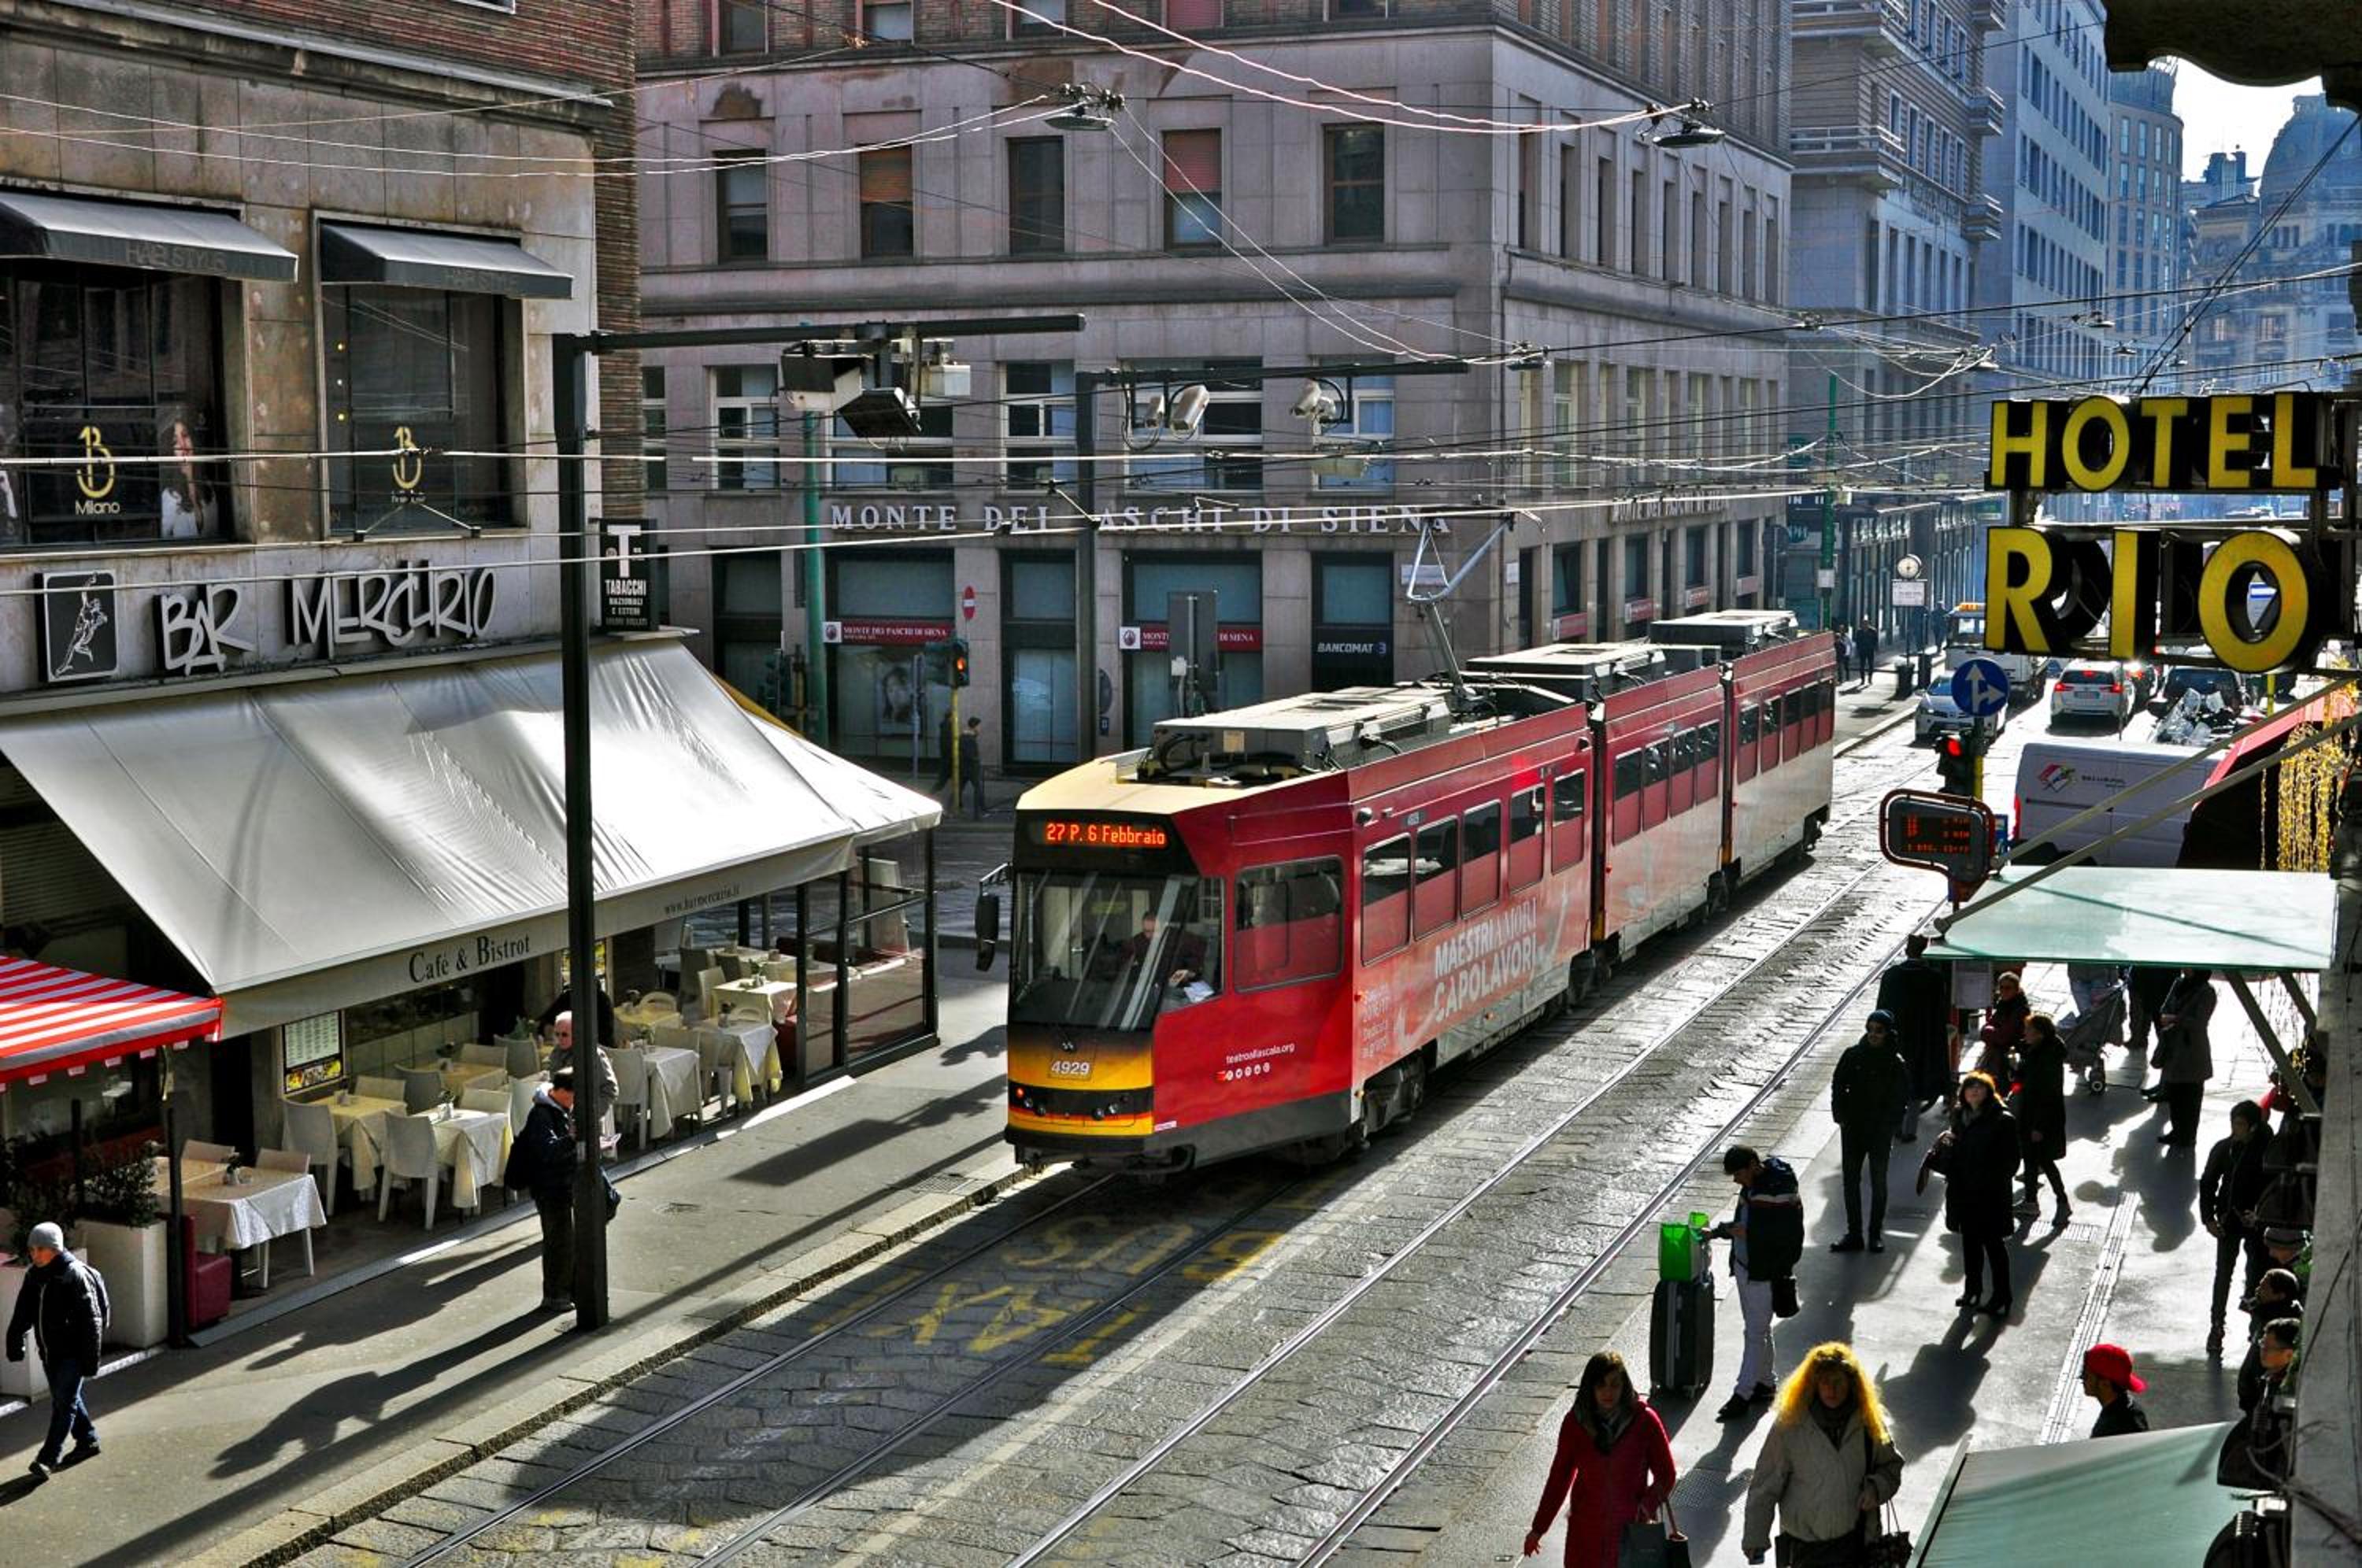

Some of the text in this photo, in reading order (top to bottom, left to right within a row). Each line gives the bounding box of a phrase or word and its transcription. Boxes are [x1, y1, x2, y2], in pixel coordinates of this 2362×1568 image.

[1990, 395, 2318, 492] HOTEL
[75, 500, 121, 516] Milano
[831, 505, 1450, 533] MONTE DEI ASCHI DI SIENA
[606, 524, 642, 578] T
[605, 579, 646, 596] TABACCHI
[1985, 527, 2309, 674] RIO
[162, 560, 497, 676] BAR MERCURIO
[1142, 632, 1169, 641] MONT
[1317, 642, 1374, 654] BANCOMAT
[1046, 823, 1065, 841] 27
[1087, 824, 1098, 841] 6
[1102, 825, 1166, 845] Febbraio
[409, 933, 530, 983] Café & Bistrot
[1435, 918, 1494, 979] MAESTRI
[1433, 930, 1537, 1023] CAPOLAVORI
[1051, 1060, 1090, 1076] 4929
